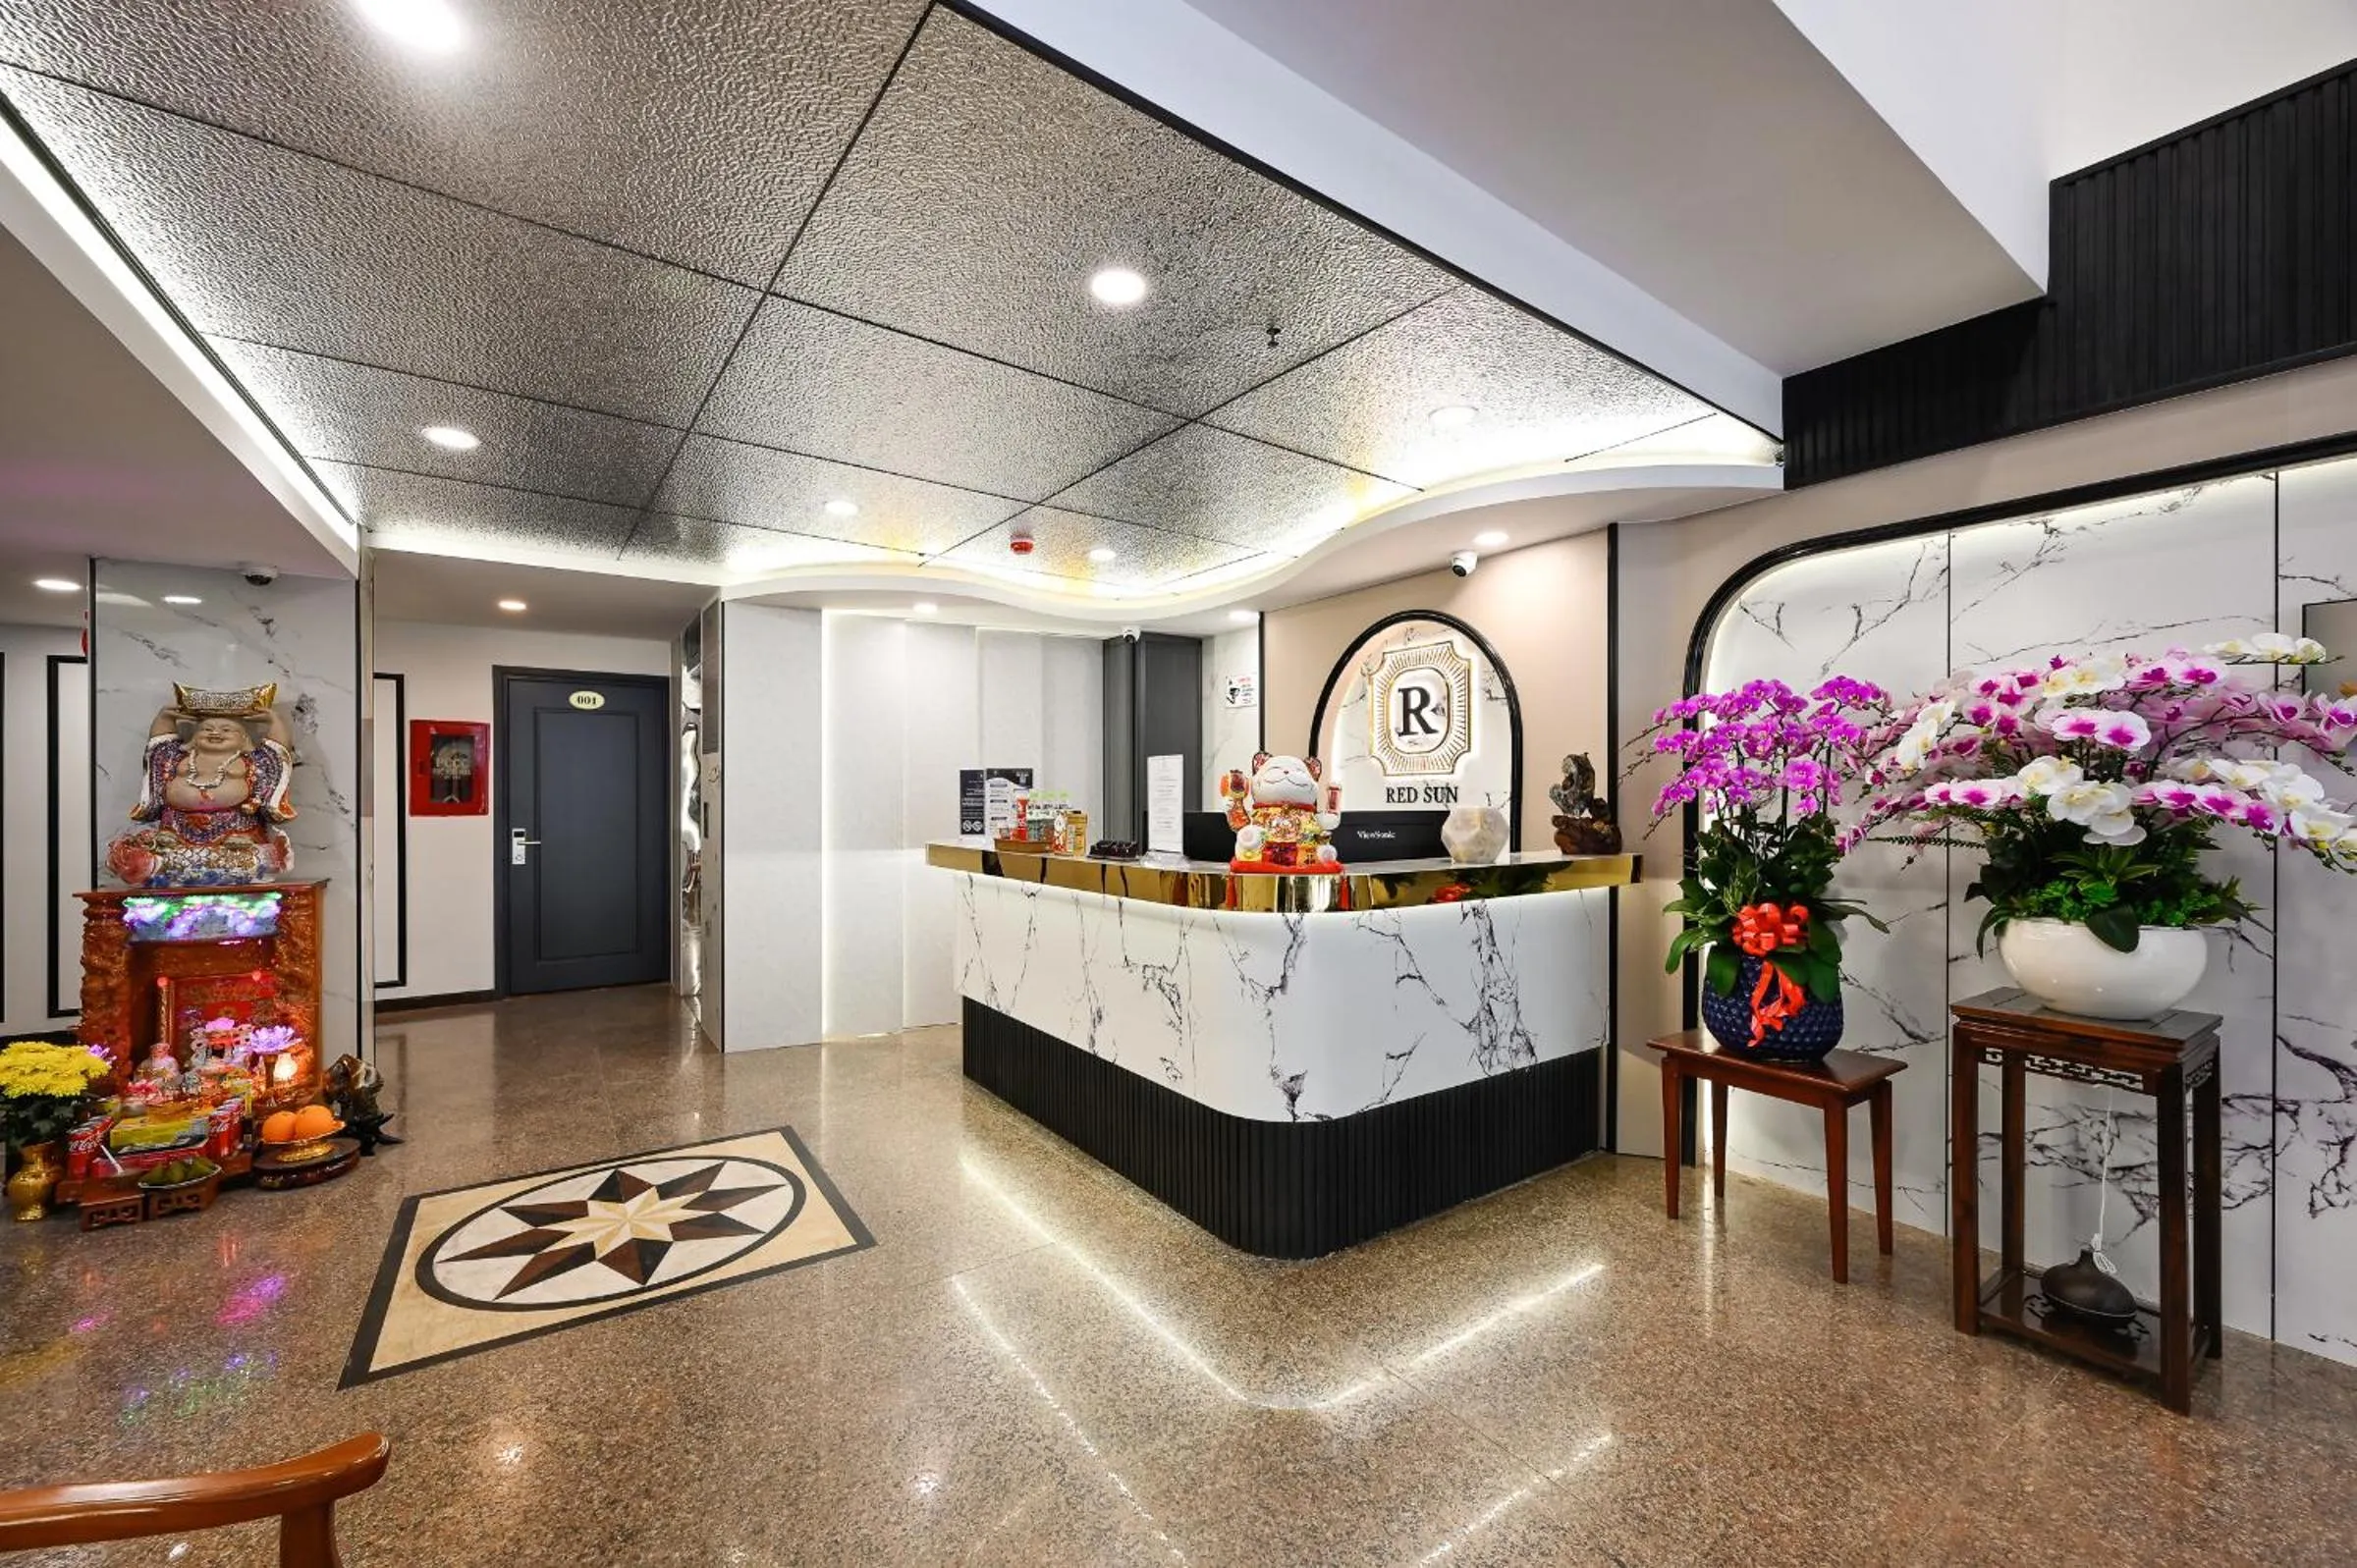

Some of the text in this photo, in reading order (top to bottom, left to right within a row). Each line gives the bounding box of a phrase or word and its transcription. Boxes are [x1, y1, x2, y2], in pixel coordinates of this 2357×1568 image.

[1398, 686, 1439, 736] R
[1386, 786, 1458, 803] RED SUN
